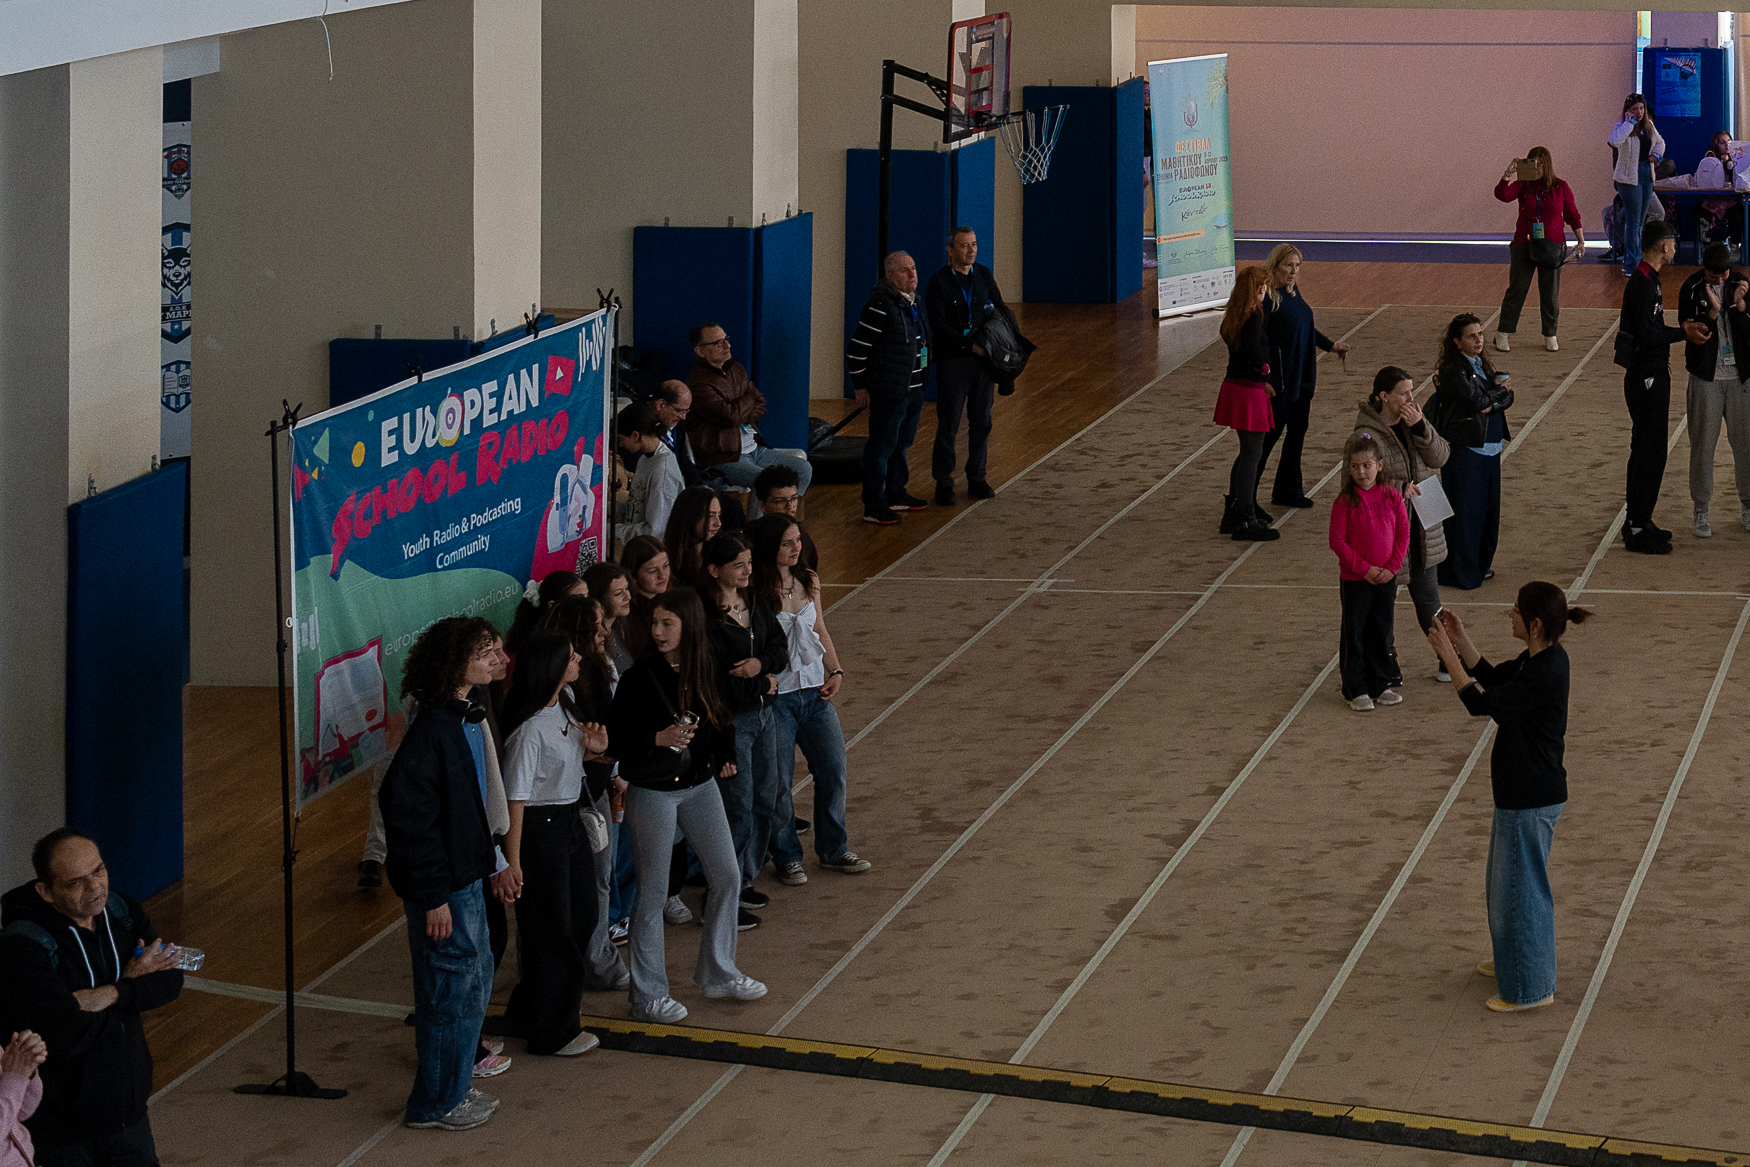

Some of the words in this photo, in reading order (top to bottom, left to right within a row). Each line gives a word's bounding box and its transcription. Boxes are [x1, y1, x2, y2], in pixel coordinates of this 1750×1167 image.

[1162, 153, 1202, 170] ΜΑΘΗΤΙΚΟΥ
[1174, 164, 1218, 181] ΡΑΔΙΟΦΩΝΟΥ
[330, 451, 467, 576] SCHOOL
[476, 410, 569, 486] RADIO
[402, 534, 430, 560] Youth
[433, 524, 460, 547] Radio
[460, 517, 470, 532] &
[470, 498, 522, 527] Podcasting
[436, 534, 490, 570] Community
